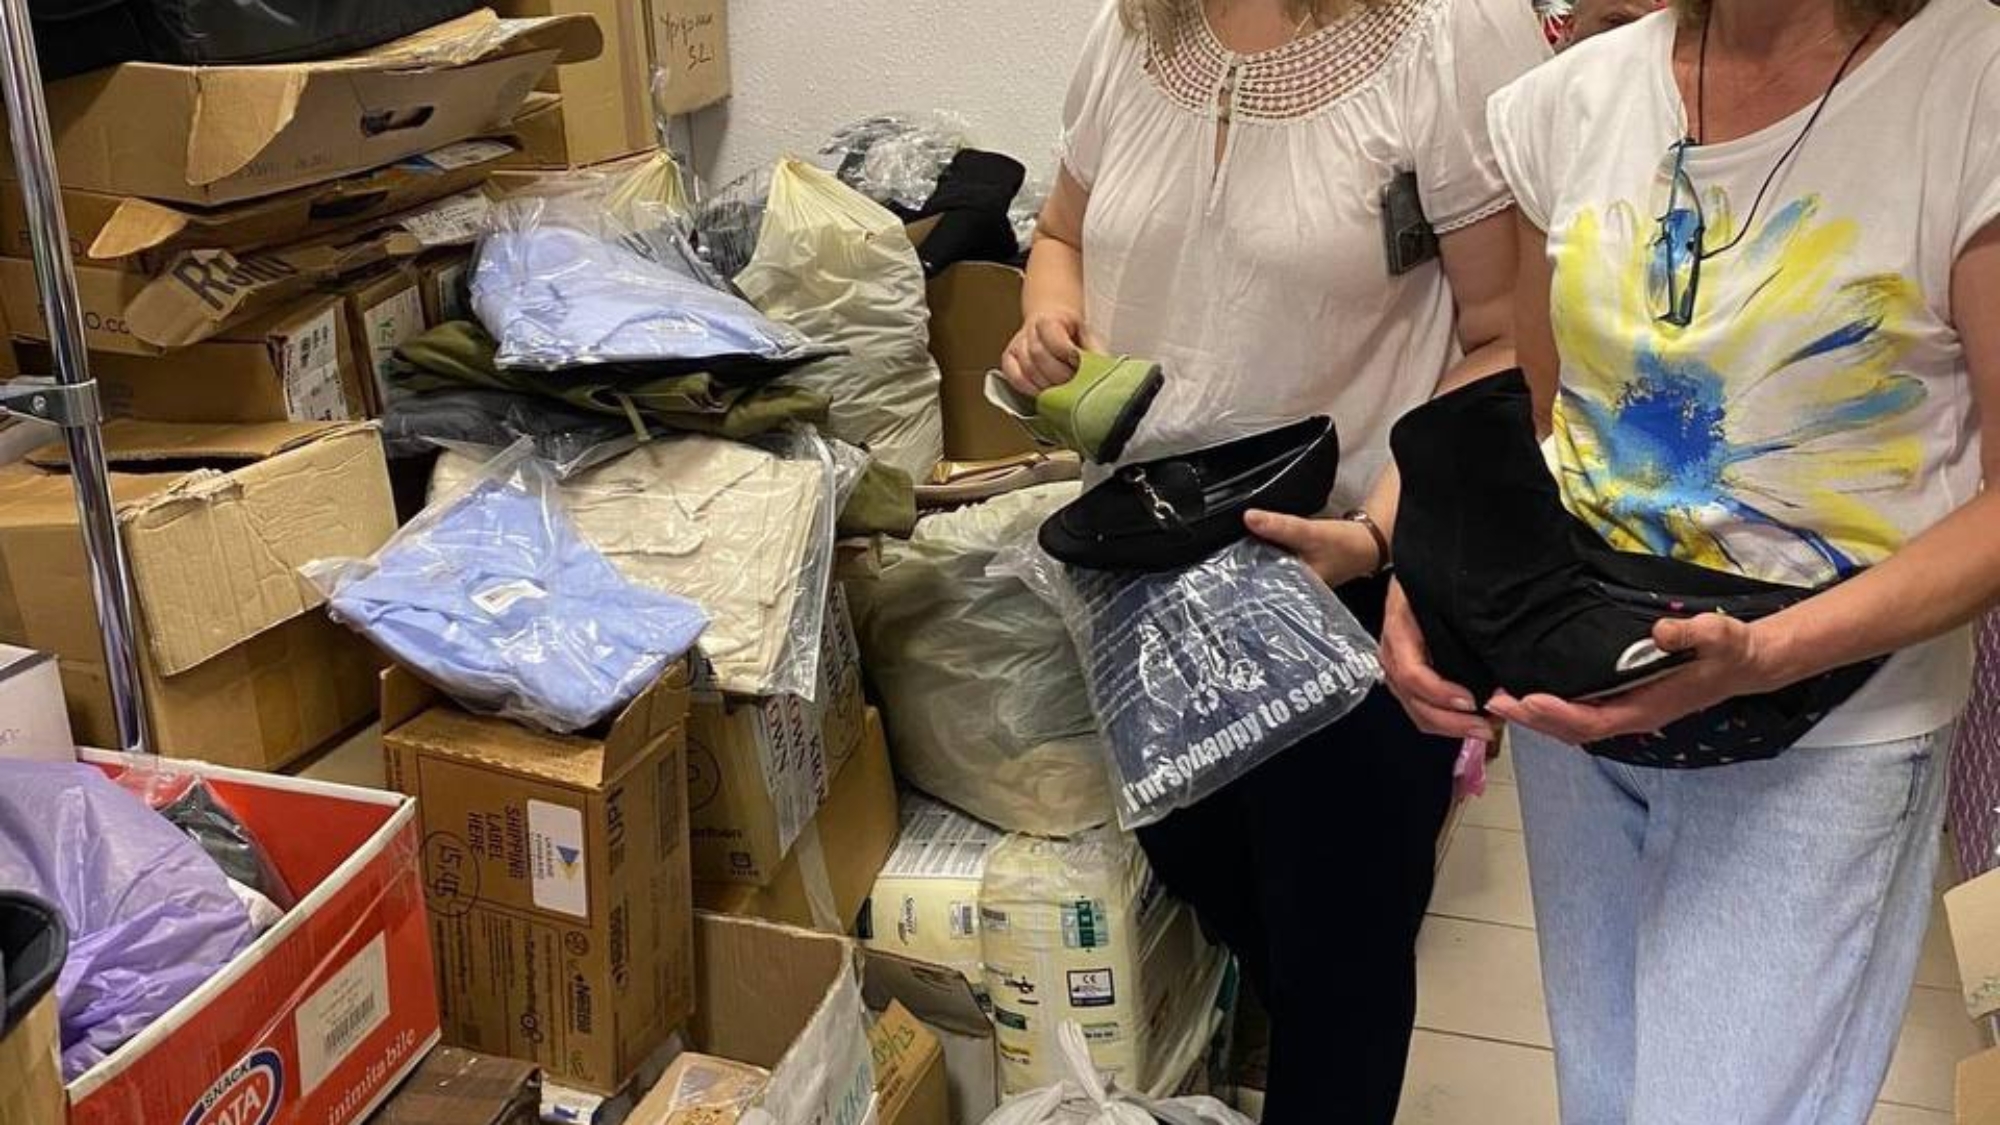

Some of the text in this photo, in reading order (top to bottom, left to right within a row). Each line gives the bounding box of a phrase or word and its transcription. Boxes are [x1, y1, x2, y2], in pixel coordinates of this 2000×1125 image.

[1185, 711, 1263, 771] happy
[1258, 698, 1290, 728] to
[1288, 667, 1338, 713] see
[468, 811, 486, 855] HERE
[486, 812, 503, 861] LABEL
[505, 806, 526, 880] SHIPPING
[205, 1063, 249, 1108] SNACK
[328, 1028, 416, 1125] inimitabile
